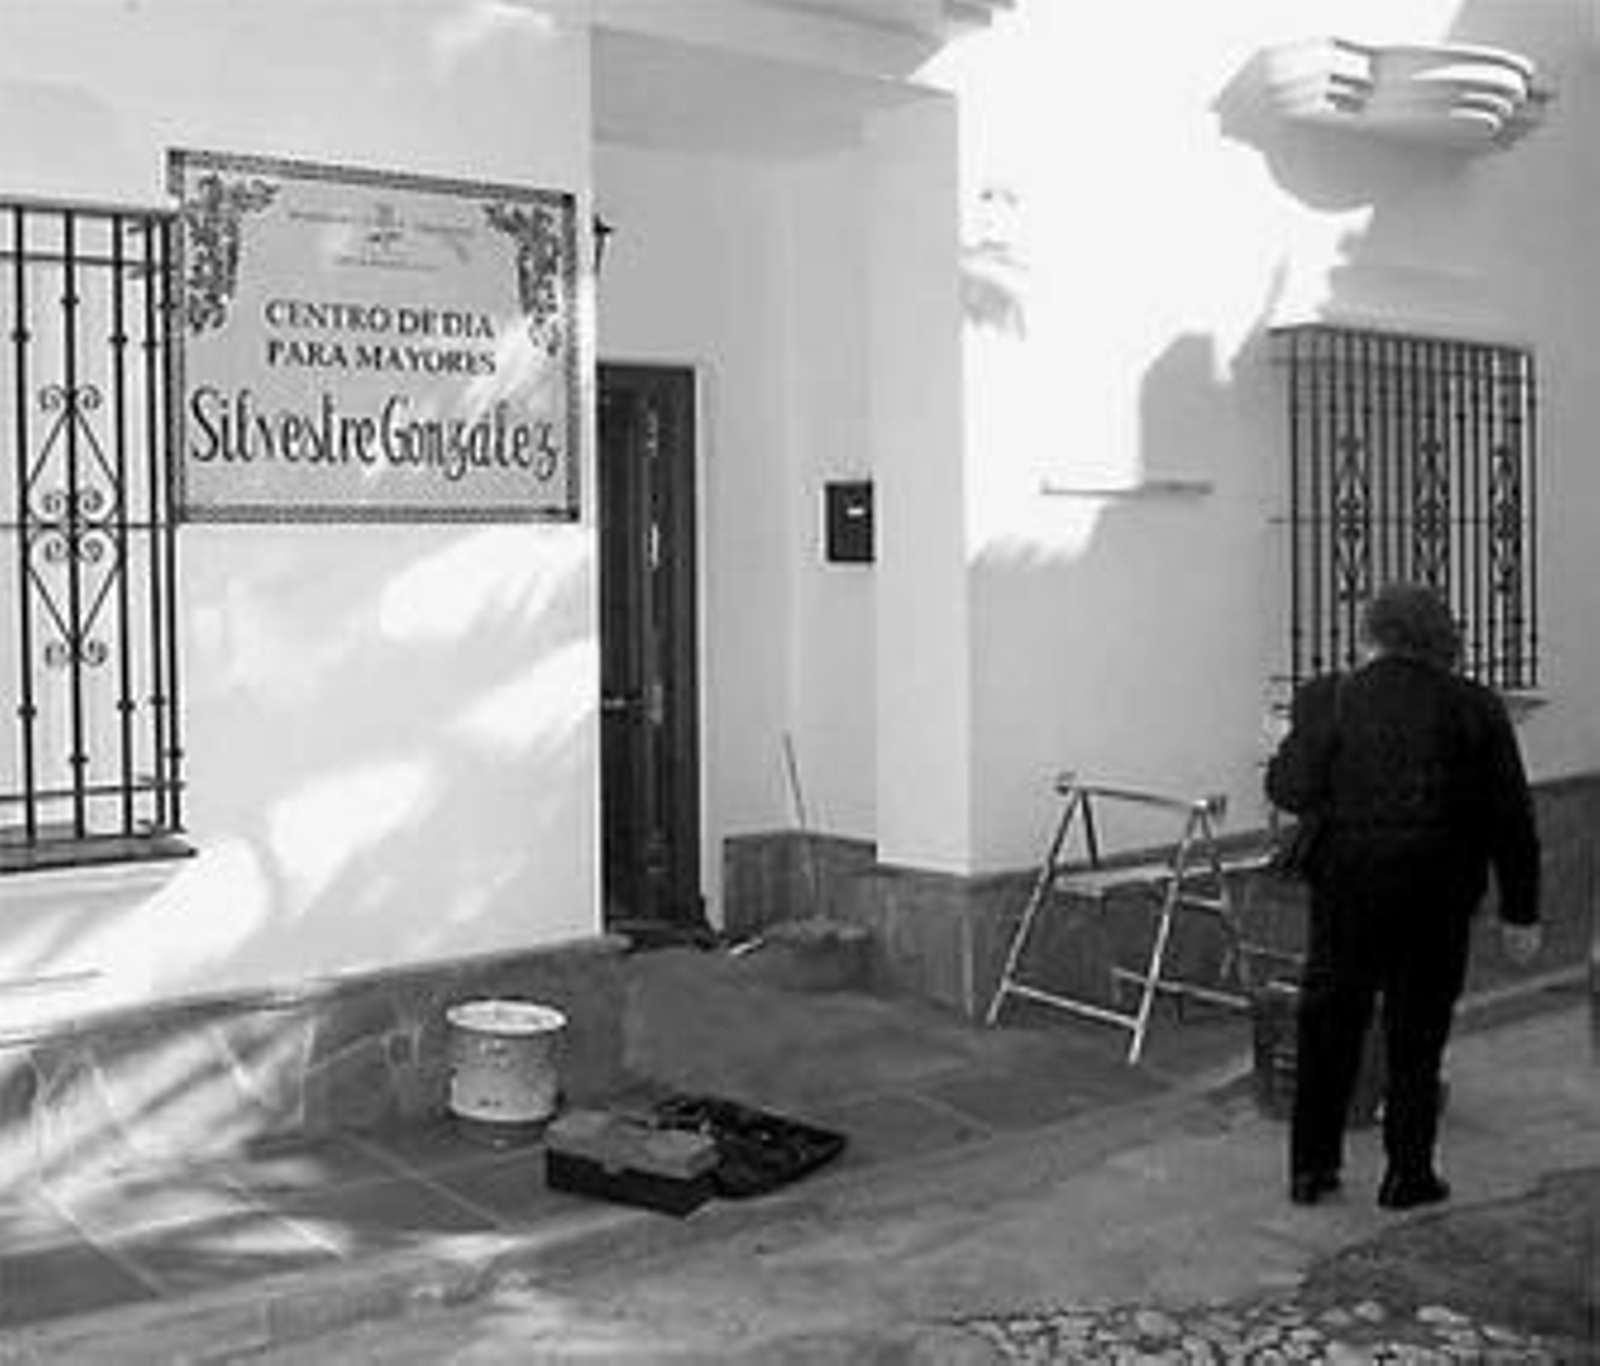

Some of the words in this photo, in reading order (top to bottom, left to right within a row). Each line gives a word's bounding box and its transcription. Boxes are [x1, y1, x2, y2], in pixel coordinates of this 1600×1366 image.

[265, 302, 391, 334] CENTRO
[397, 308, 437, 334] DE
[267, 340, 347, 368] PARA
[355, 344, 496, 376] MAYORES
[190, 386, 377, 465] Silvestre
